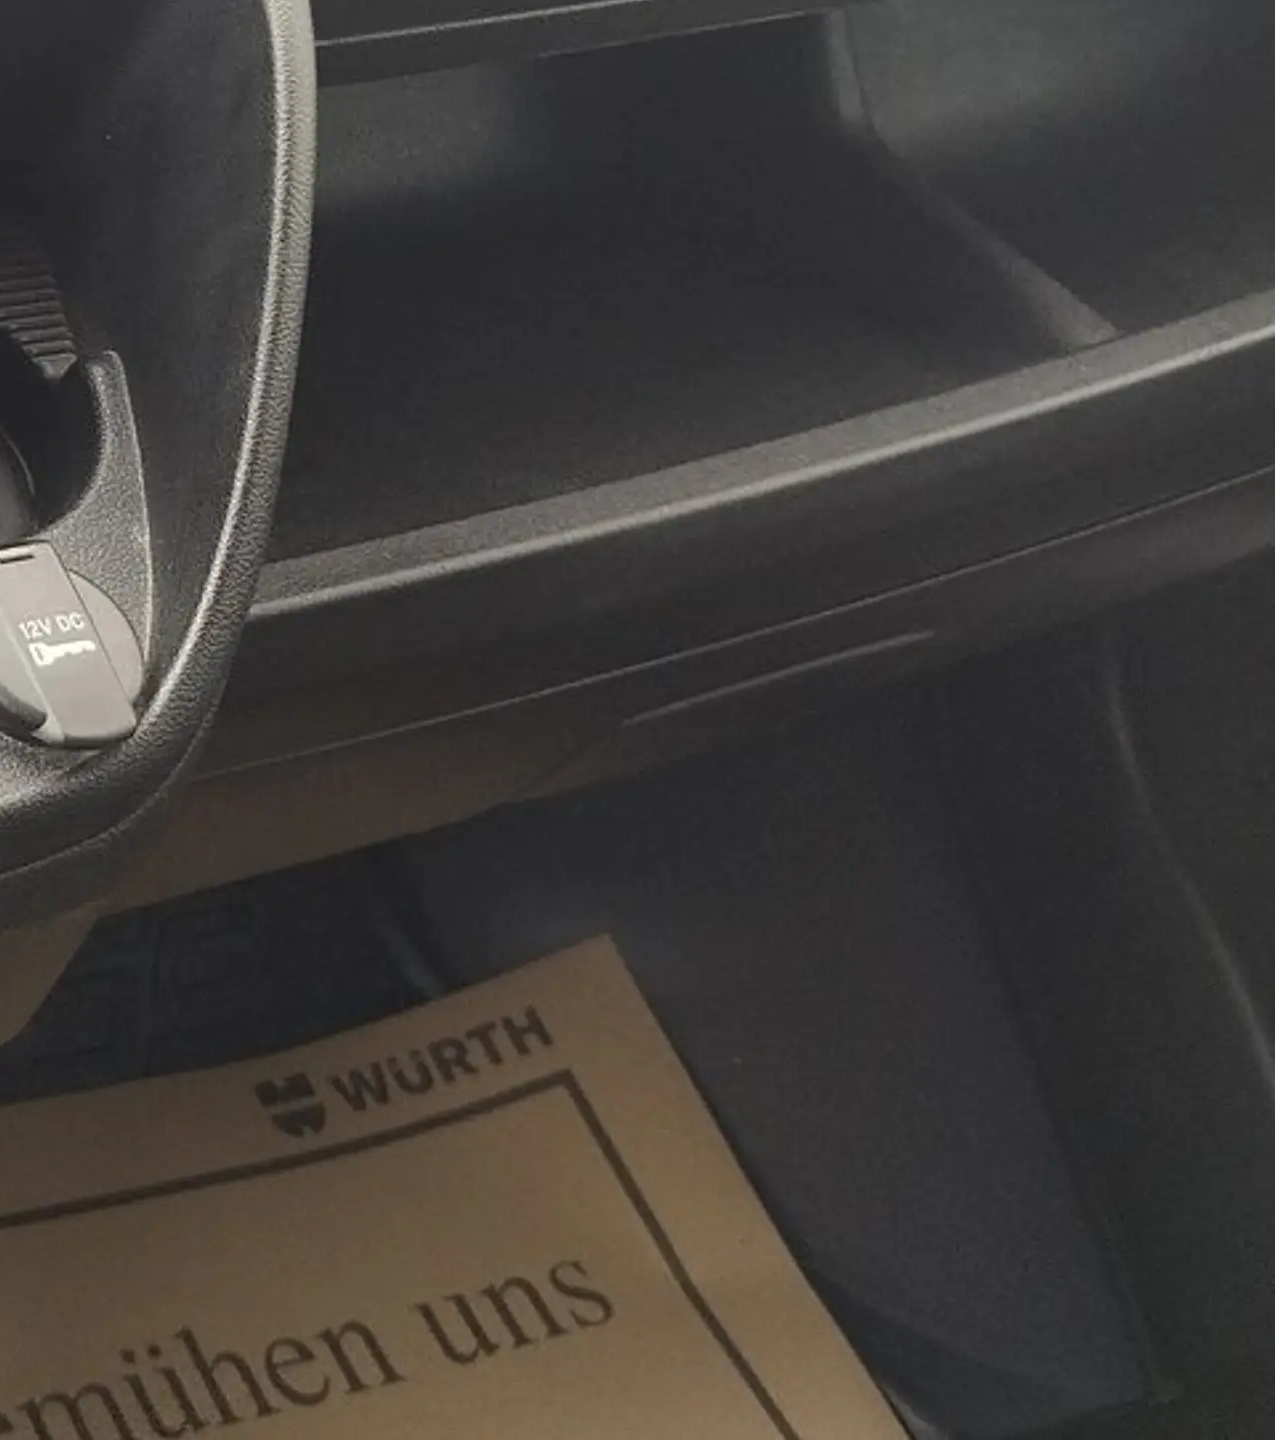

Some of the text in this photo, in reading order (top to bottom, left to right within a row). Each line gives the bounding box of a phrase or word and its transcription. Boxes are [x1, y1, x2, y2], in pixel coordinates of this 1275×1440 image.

[17, 611, 86, 640] 12V DC
[411, 1259, 615, 1366] uns
